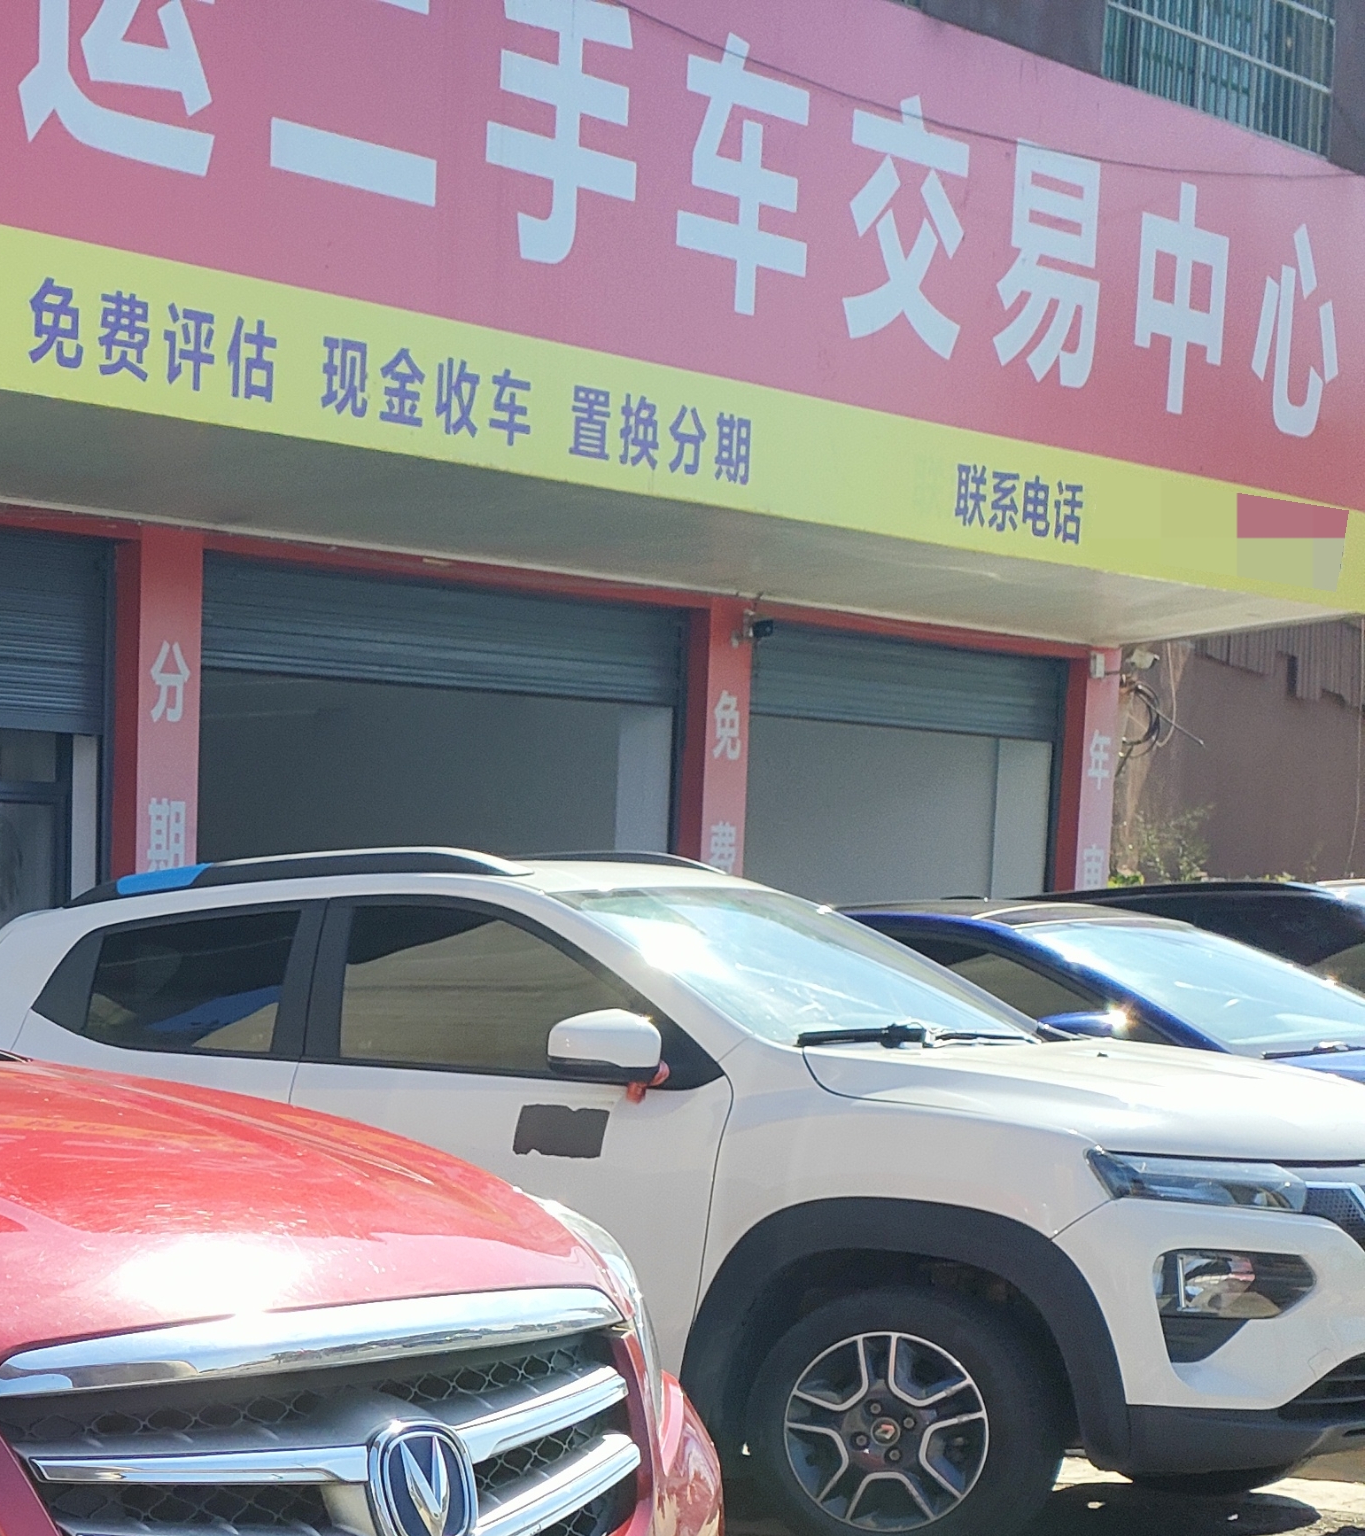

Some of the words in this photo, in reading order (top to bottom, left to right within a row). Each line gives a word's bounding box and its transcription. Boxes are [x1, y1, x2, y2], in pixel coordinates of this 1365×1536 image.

[28, 277, 277, 402] 免费评估
[321, 336, 531, 446] 现金收车
[569, 385, 751, 485] 置换分期
[954, 463, 1083, 545] 联系电话
[147, 640, 191, 873] 分期
